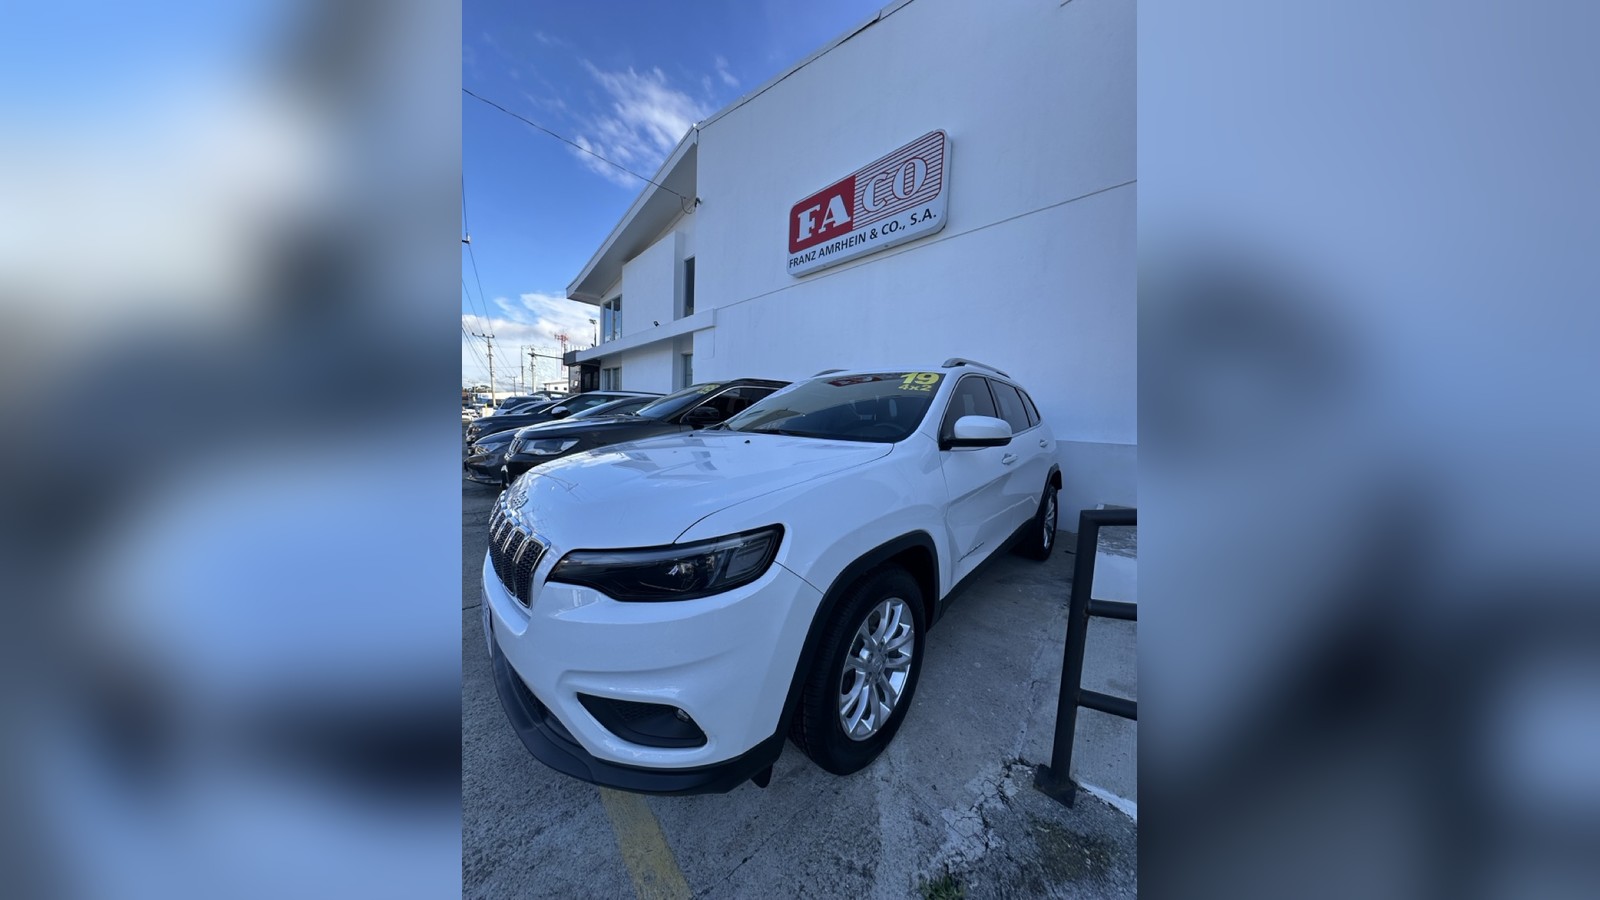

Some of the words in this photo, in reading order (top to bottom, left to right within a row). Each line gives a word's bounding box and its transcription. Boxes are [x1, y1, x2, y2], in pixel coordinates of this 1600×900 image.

[796, 156, 928, 243] FACO
[789, 250, 816, 268] FRANZ
[818, 232, 866, 258] AMRHEIN
[869, 228, 878, 240] &
[881, 220, 906, 235] CO.,
[910, 208, 937, 226] S.A.
[900, 372, 939, 385] 19
